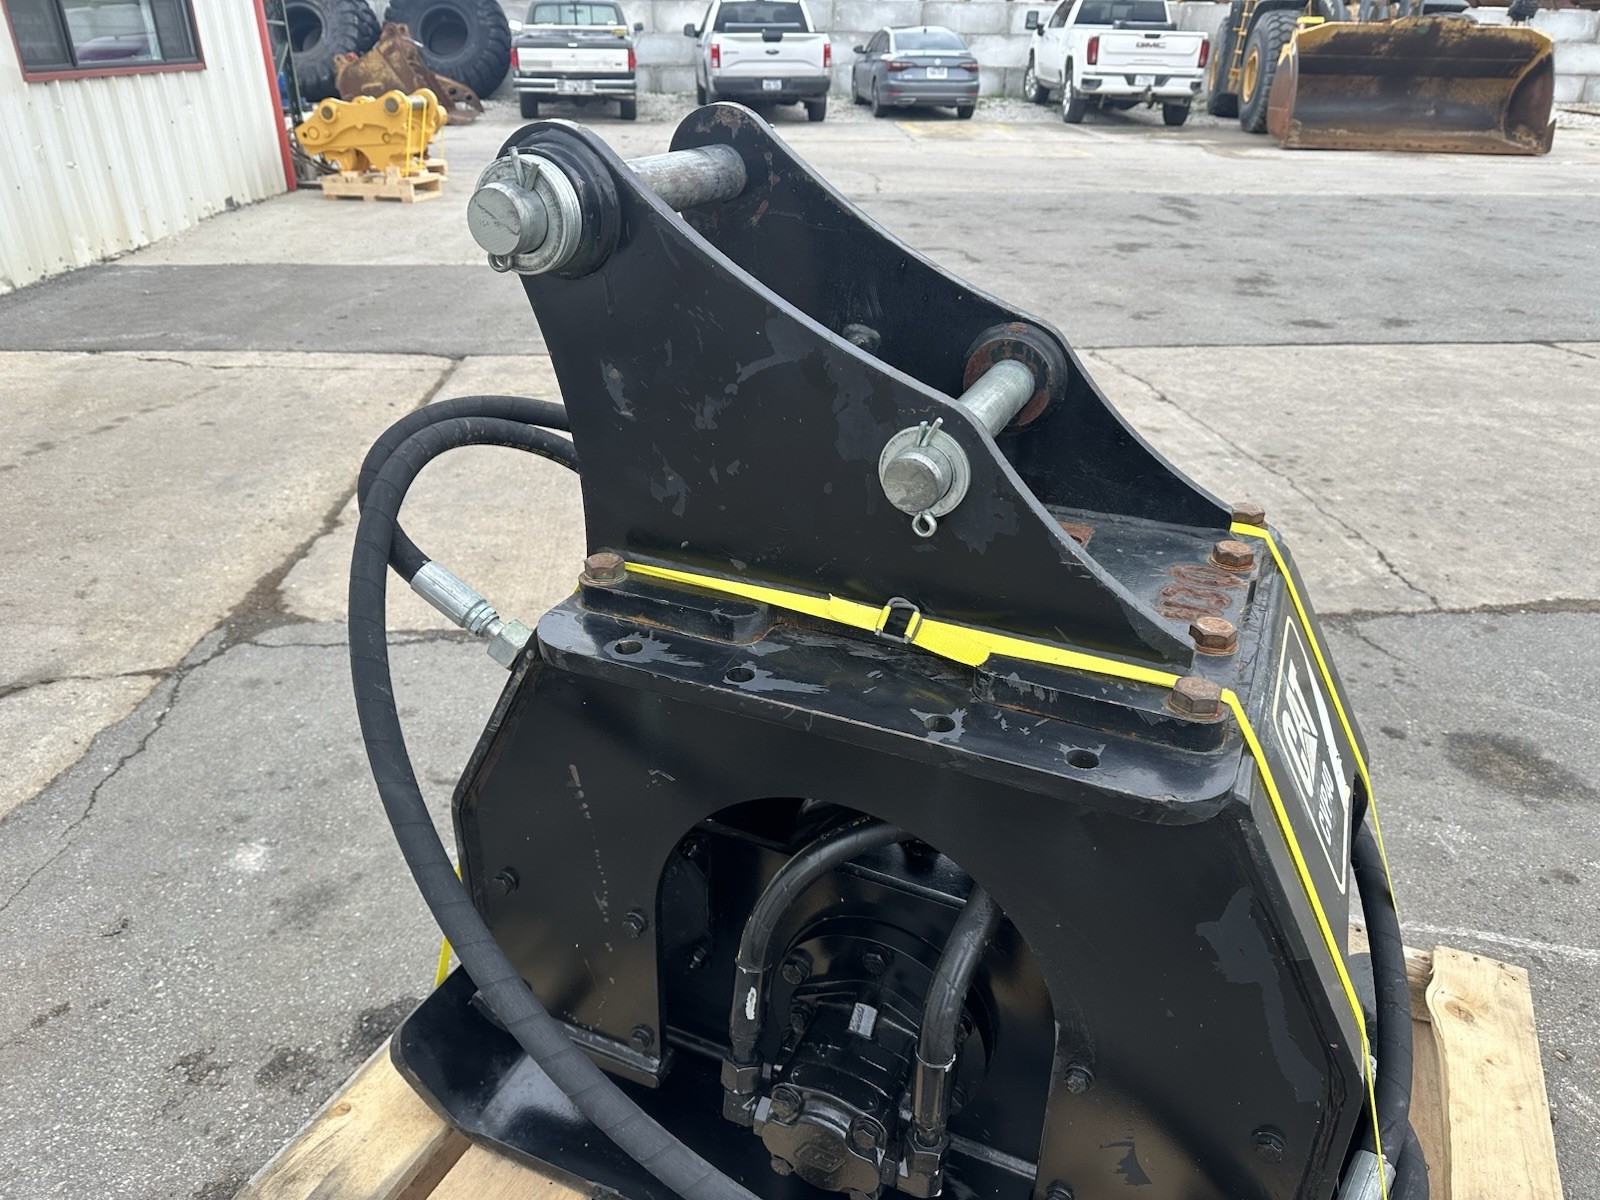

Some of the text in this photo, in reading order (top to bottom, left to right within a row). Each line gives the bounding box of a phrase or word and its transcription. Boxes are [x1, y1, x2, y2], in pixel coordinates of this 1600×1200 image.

[1136, 41, 1166, 49] GMC
[1282, 659, 1318, 797] CAT
[1319, 760, 1334, 846] CVP40
